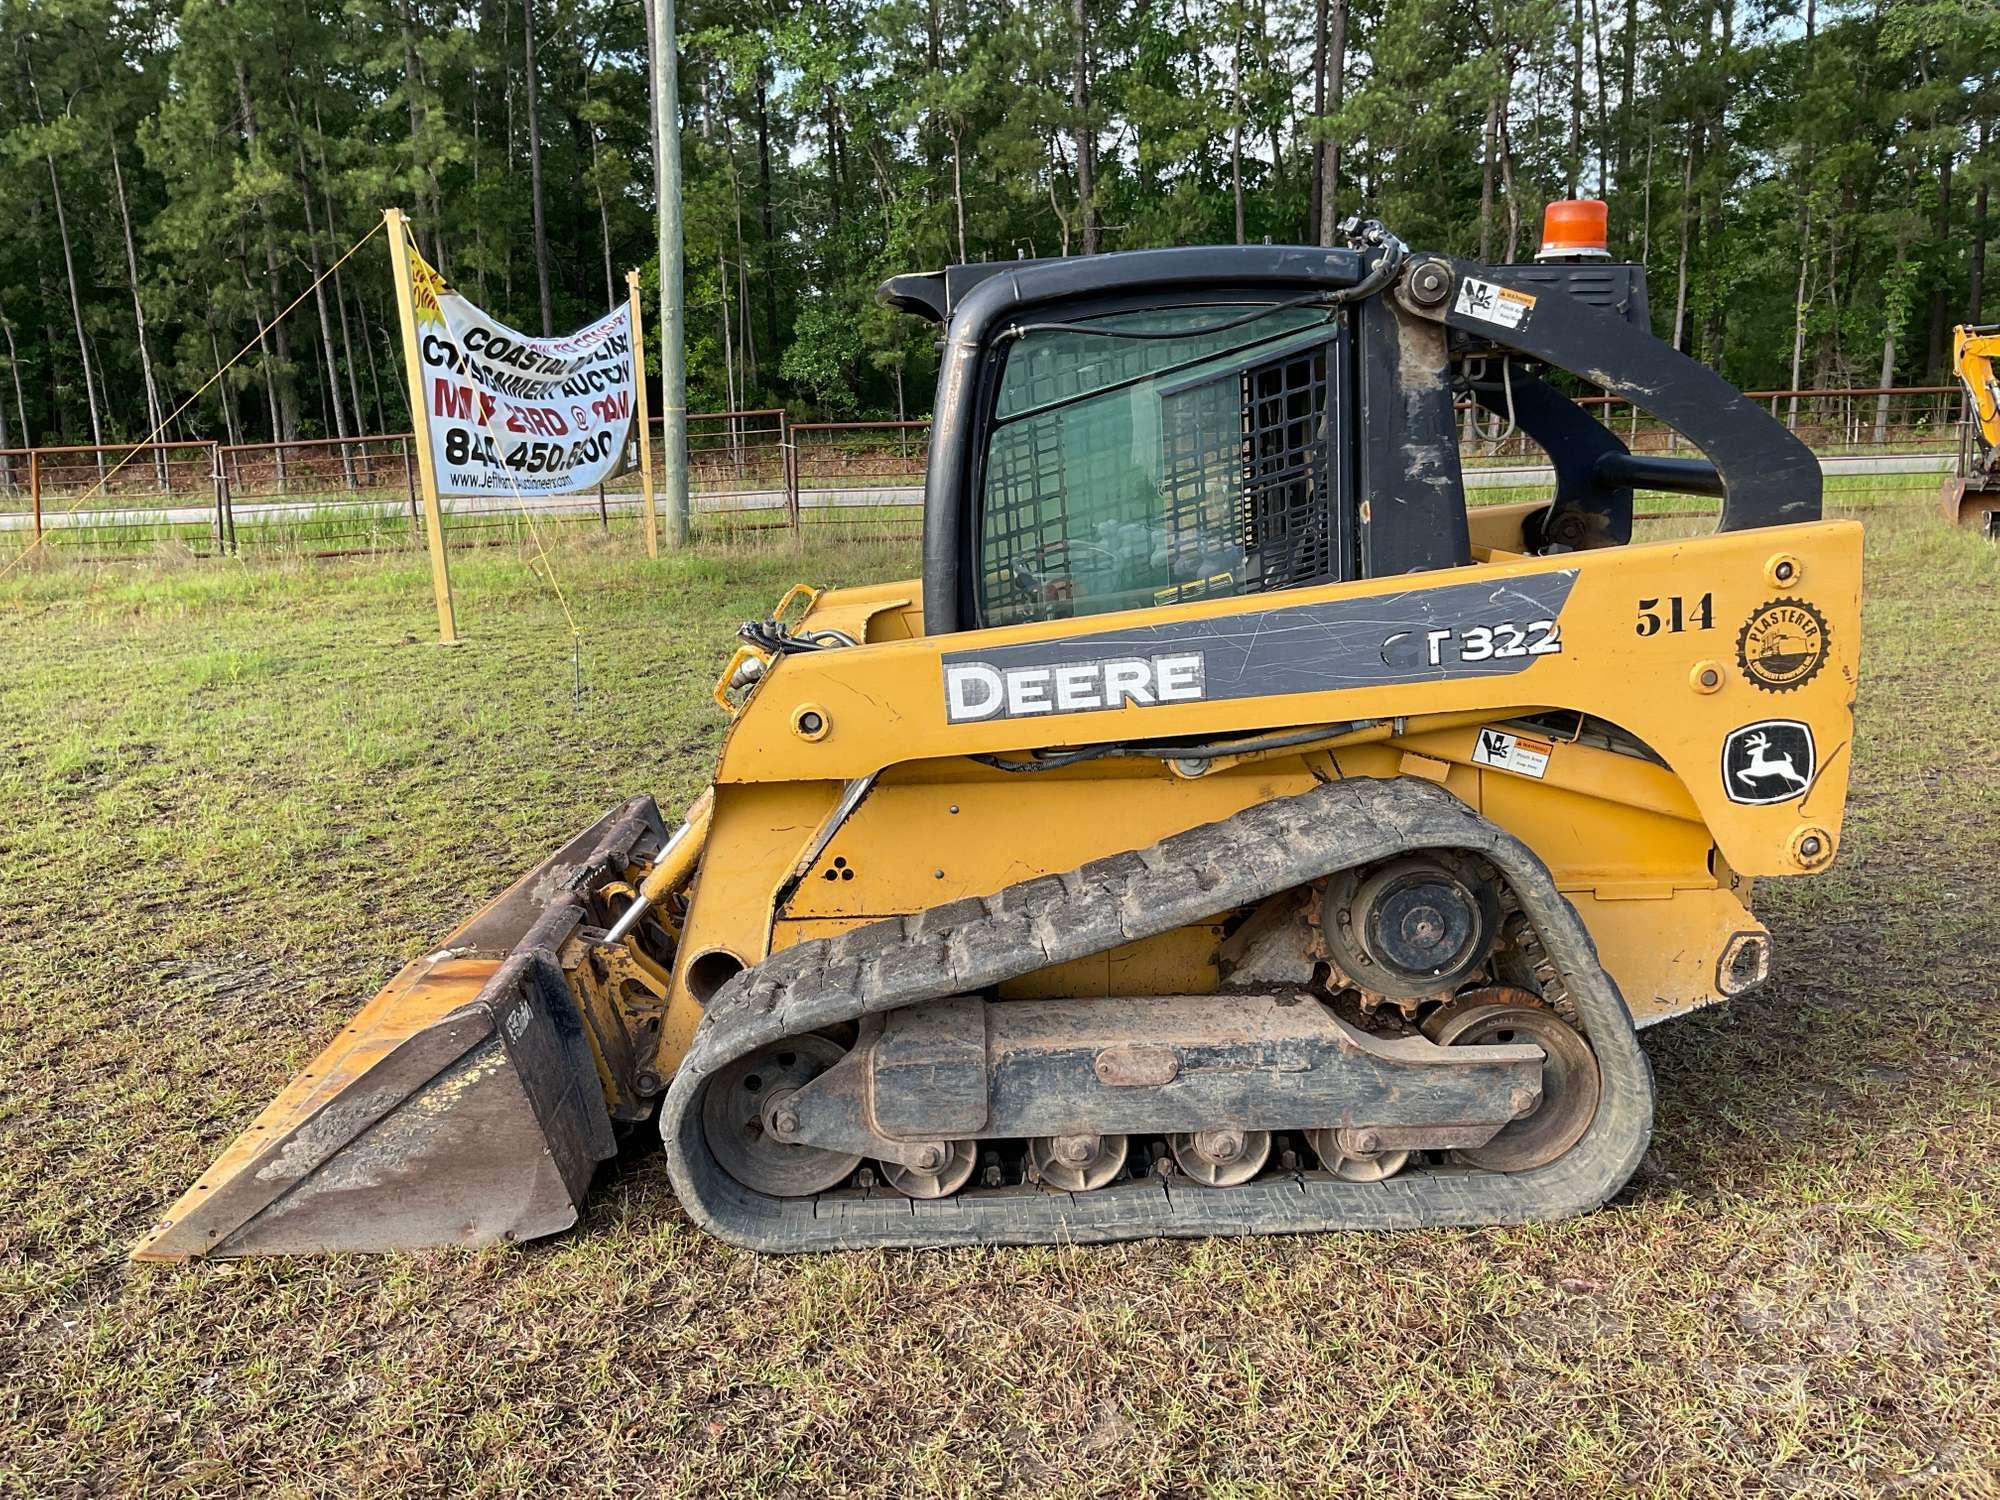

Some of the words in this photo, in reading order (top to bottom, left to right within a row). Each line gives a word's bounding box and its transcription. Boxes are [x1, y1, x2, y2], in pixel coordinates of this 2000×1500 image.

[463, 327, 568, 376] COASTAL
[504, 402, 570, 437] 23RD
[1634, 592, 1716, 638] 514
[1748, 609, 1818, 643] PLASTERER
[946, 654, 1205, 721] DEERE
